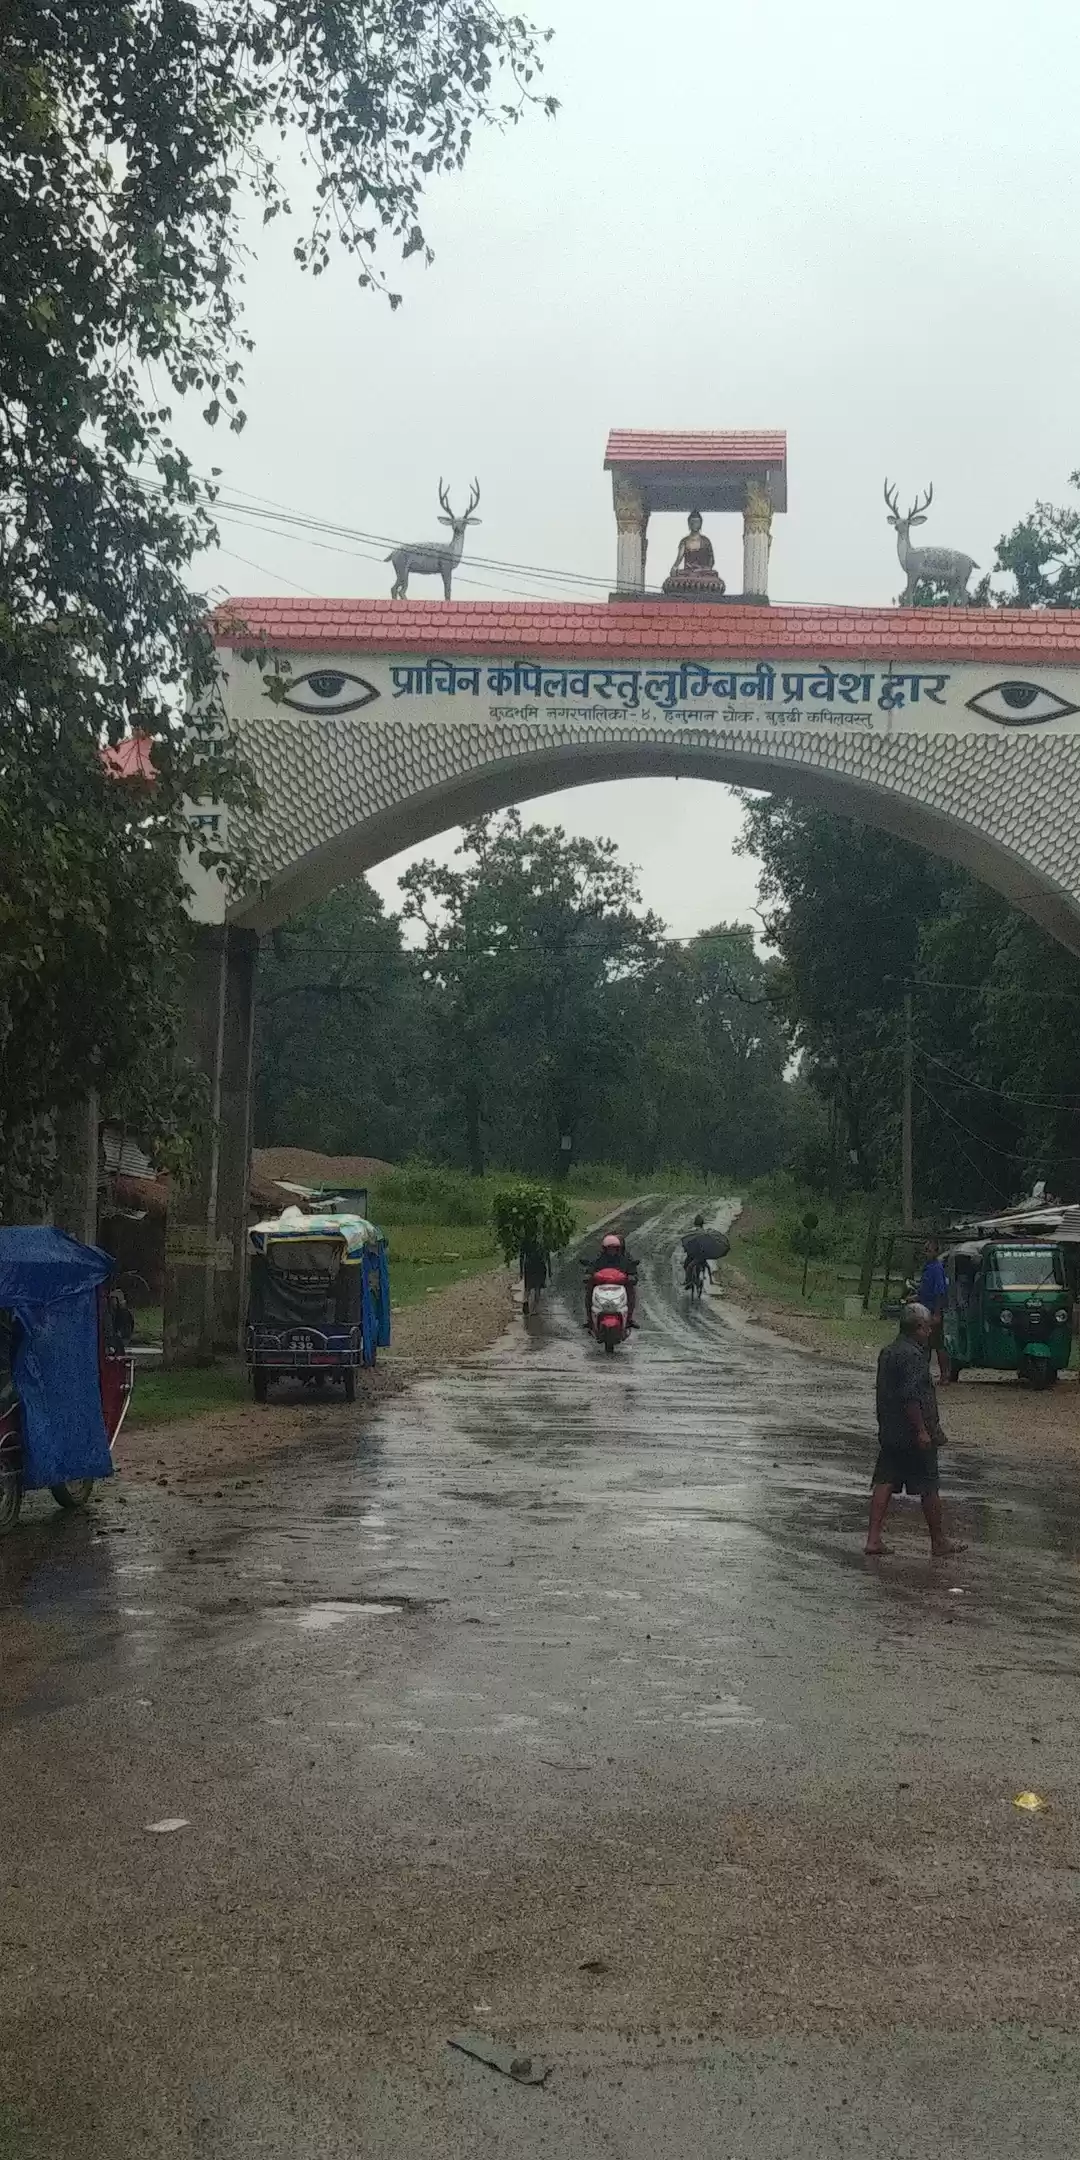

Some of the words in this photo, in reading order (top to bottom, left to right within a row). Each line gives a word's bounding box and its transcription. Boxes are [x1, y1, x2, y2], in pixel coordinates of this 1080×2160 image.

[389, 659, 481, 698] प्राचिन
[781, 664, 875, 704] प्रवेश
[878, 673, 950, 710] द्वार
[663, 709, 718, 725] हनुमान
[806, 708, 873, 729] कपिलवस्तु
